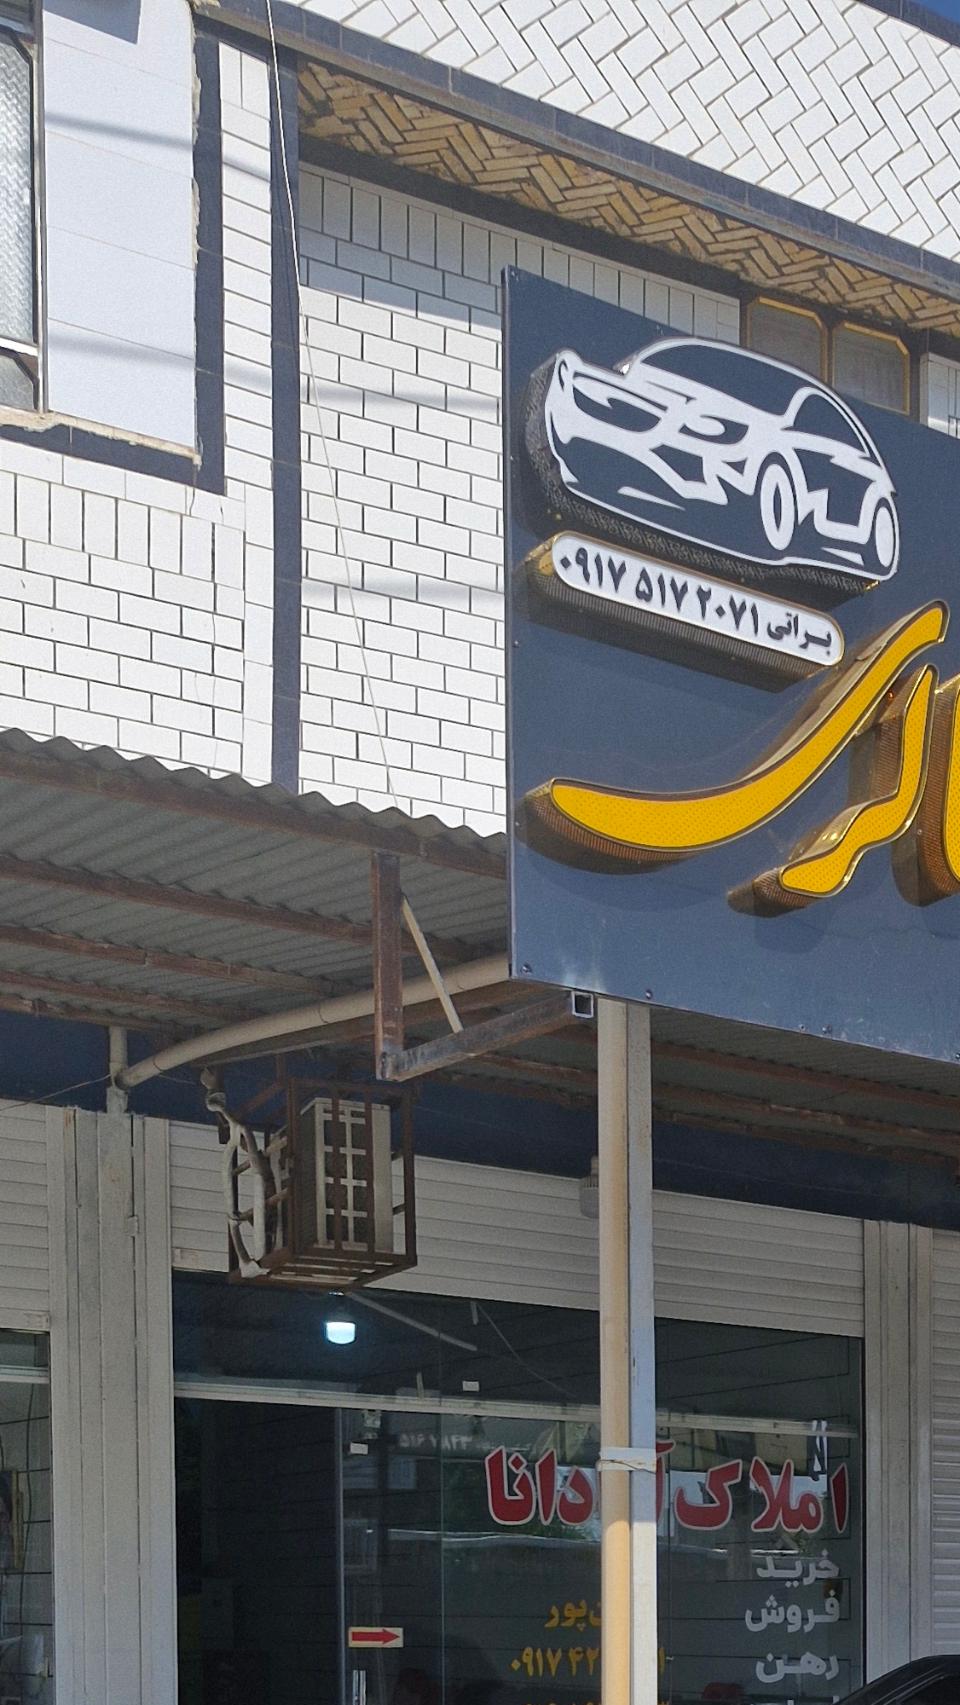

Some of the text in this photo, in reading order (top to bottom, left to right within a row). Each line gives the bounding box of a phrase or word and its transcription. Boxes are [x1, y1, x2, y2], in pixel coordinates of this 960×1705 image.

[559, 546, 627, 593] ۰۹۱۷
[635, 567, 689, 613] ۵۱۷
[696, 585, 760, 637] ۲۰۷۱
[674, 1456, 849, 1534] املاک
[756, 1549, 840, 1588] خرید
[744, 1589, 840, 1633] فروش
[511, 1646, 562, 1677] ۰۹۱۷
[755, 1651, 840, 1684] رهن
